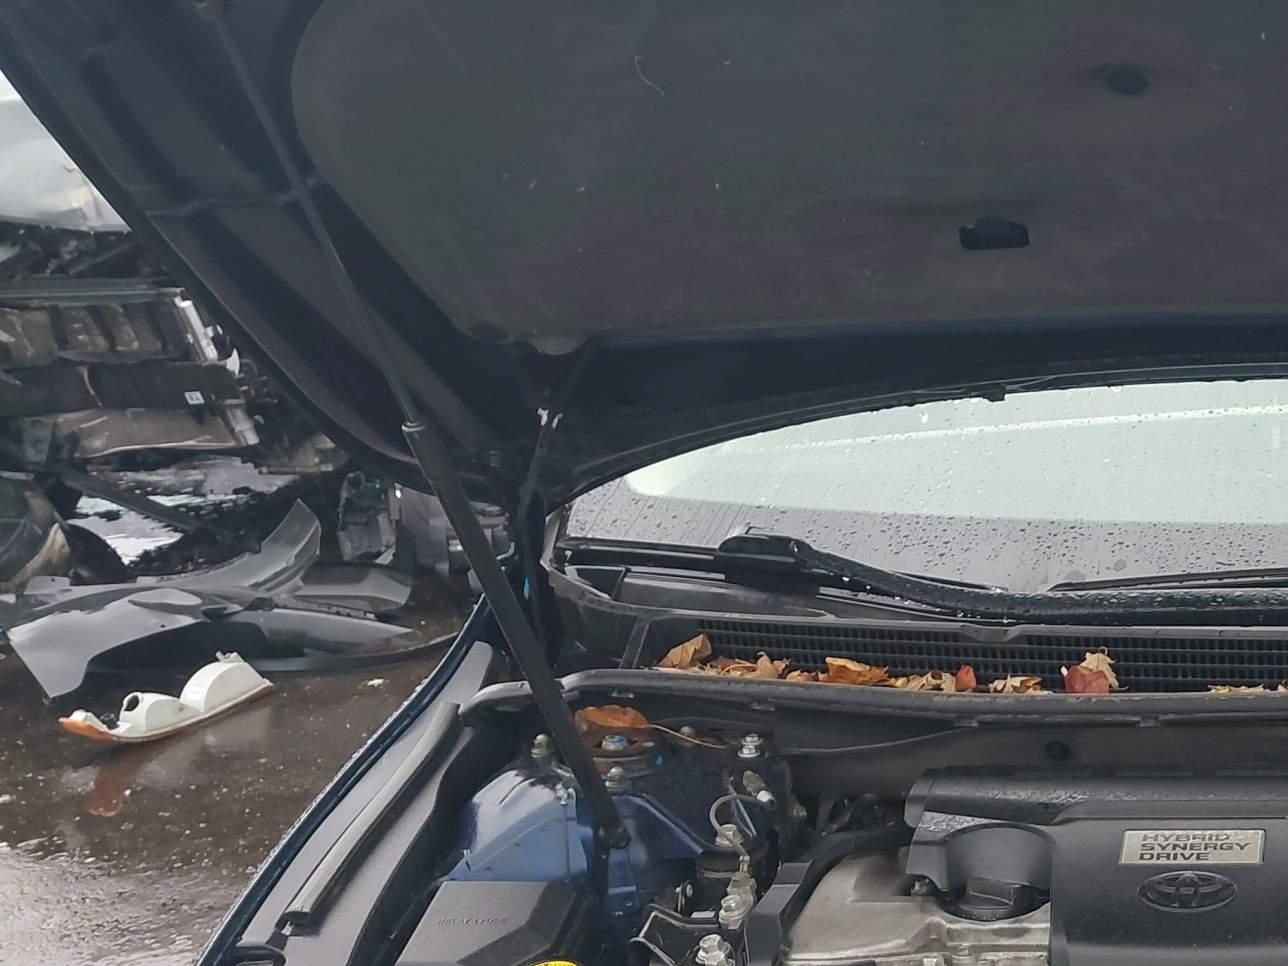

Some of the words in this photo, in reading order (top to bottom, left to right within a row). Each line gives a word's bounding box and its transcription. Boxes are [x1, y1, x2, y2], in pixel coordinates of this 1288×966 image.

[1143, 834, 1230, 842] HYBRID
[1141, 843, 1249, 851] SYNERGY
[1139, 853, 1209, 861] DRIVE
